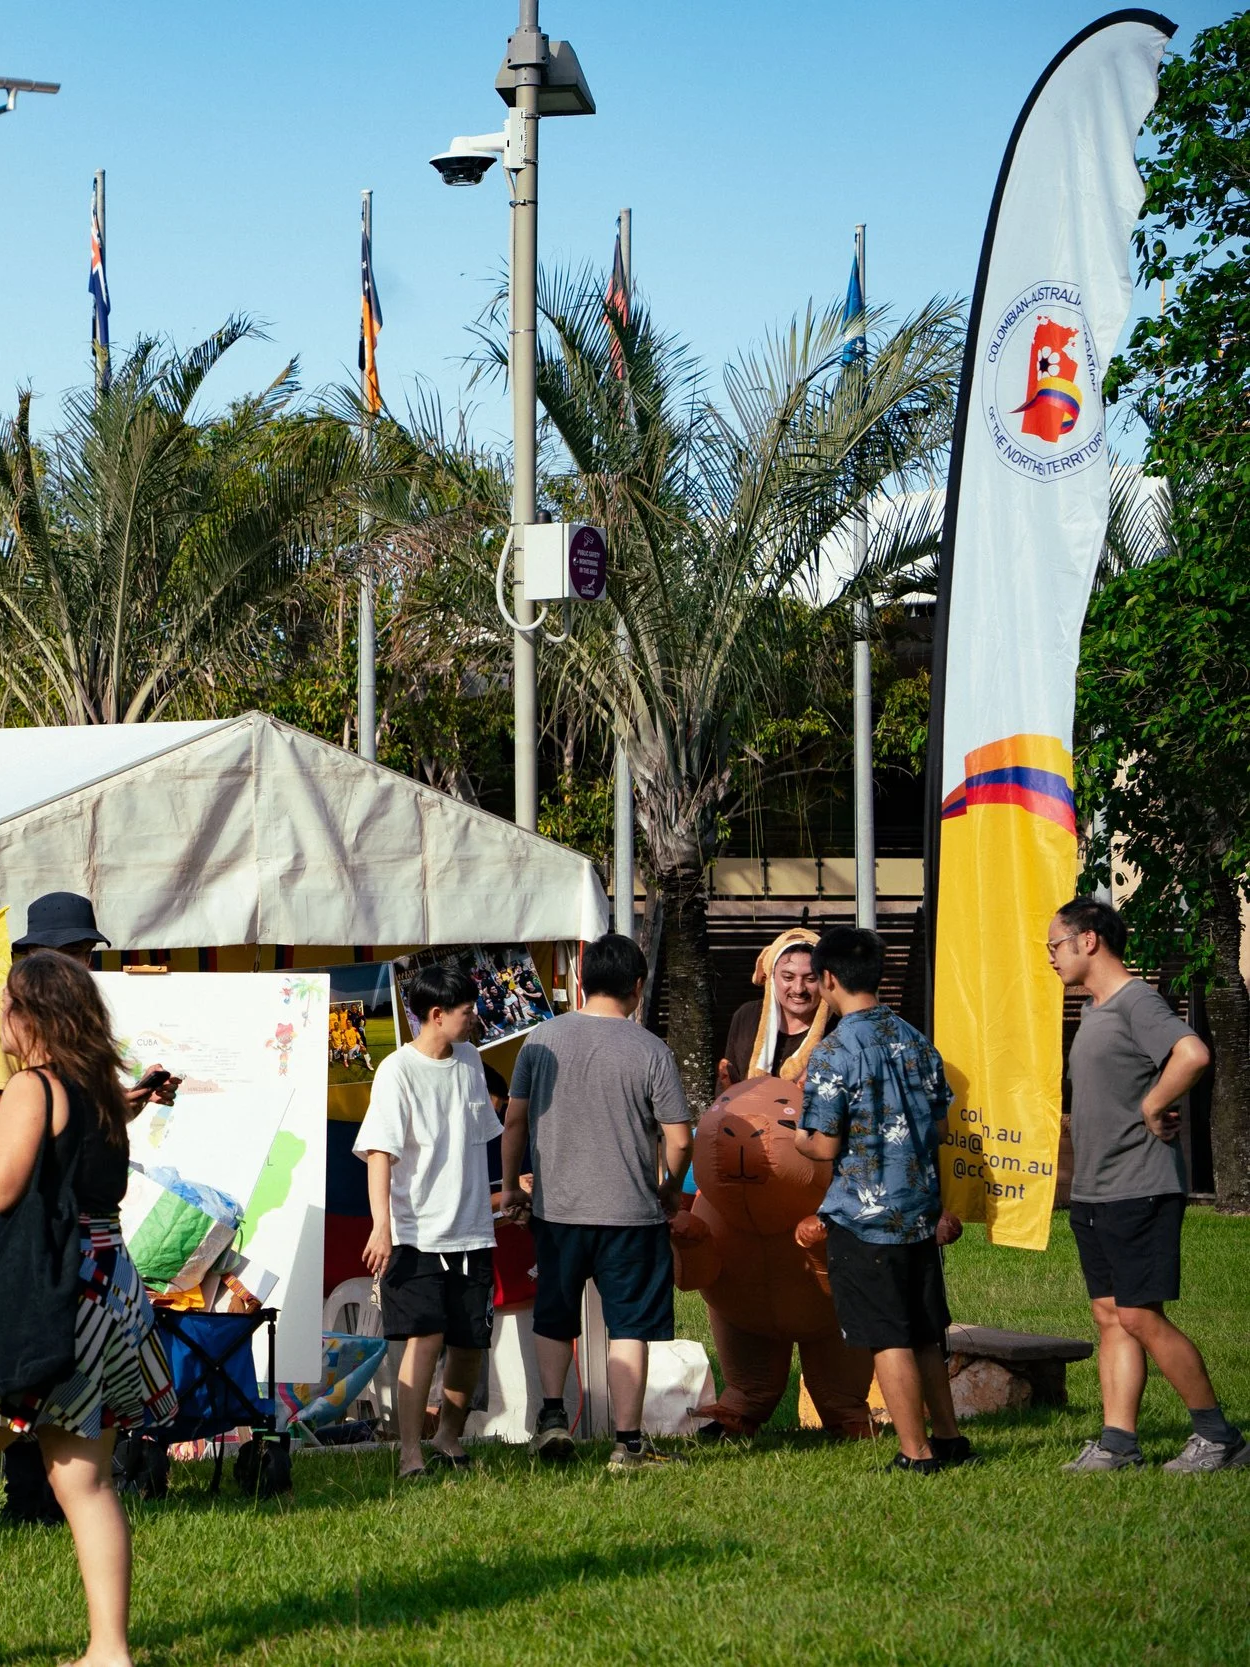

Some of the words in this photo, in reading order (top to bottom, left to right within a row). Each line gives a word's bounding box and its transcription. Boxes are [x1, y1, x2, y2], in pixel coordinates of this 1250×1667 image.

[991, 422, 1008, 450] THE
[136, 1038, 159, 1047] CUBA
[960, 1107, 983, 1123] col
